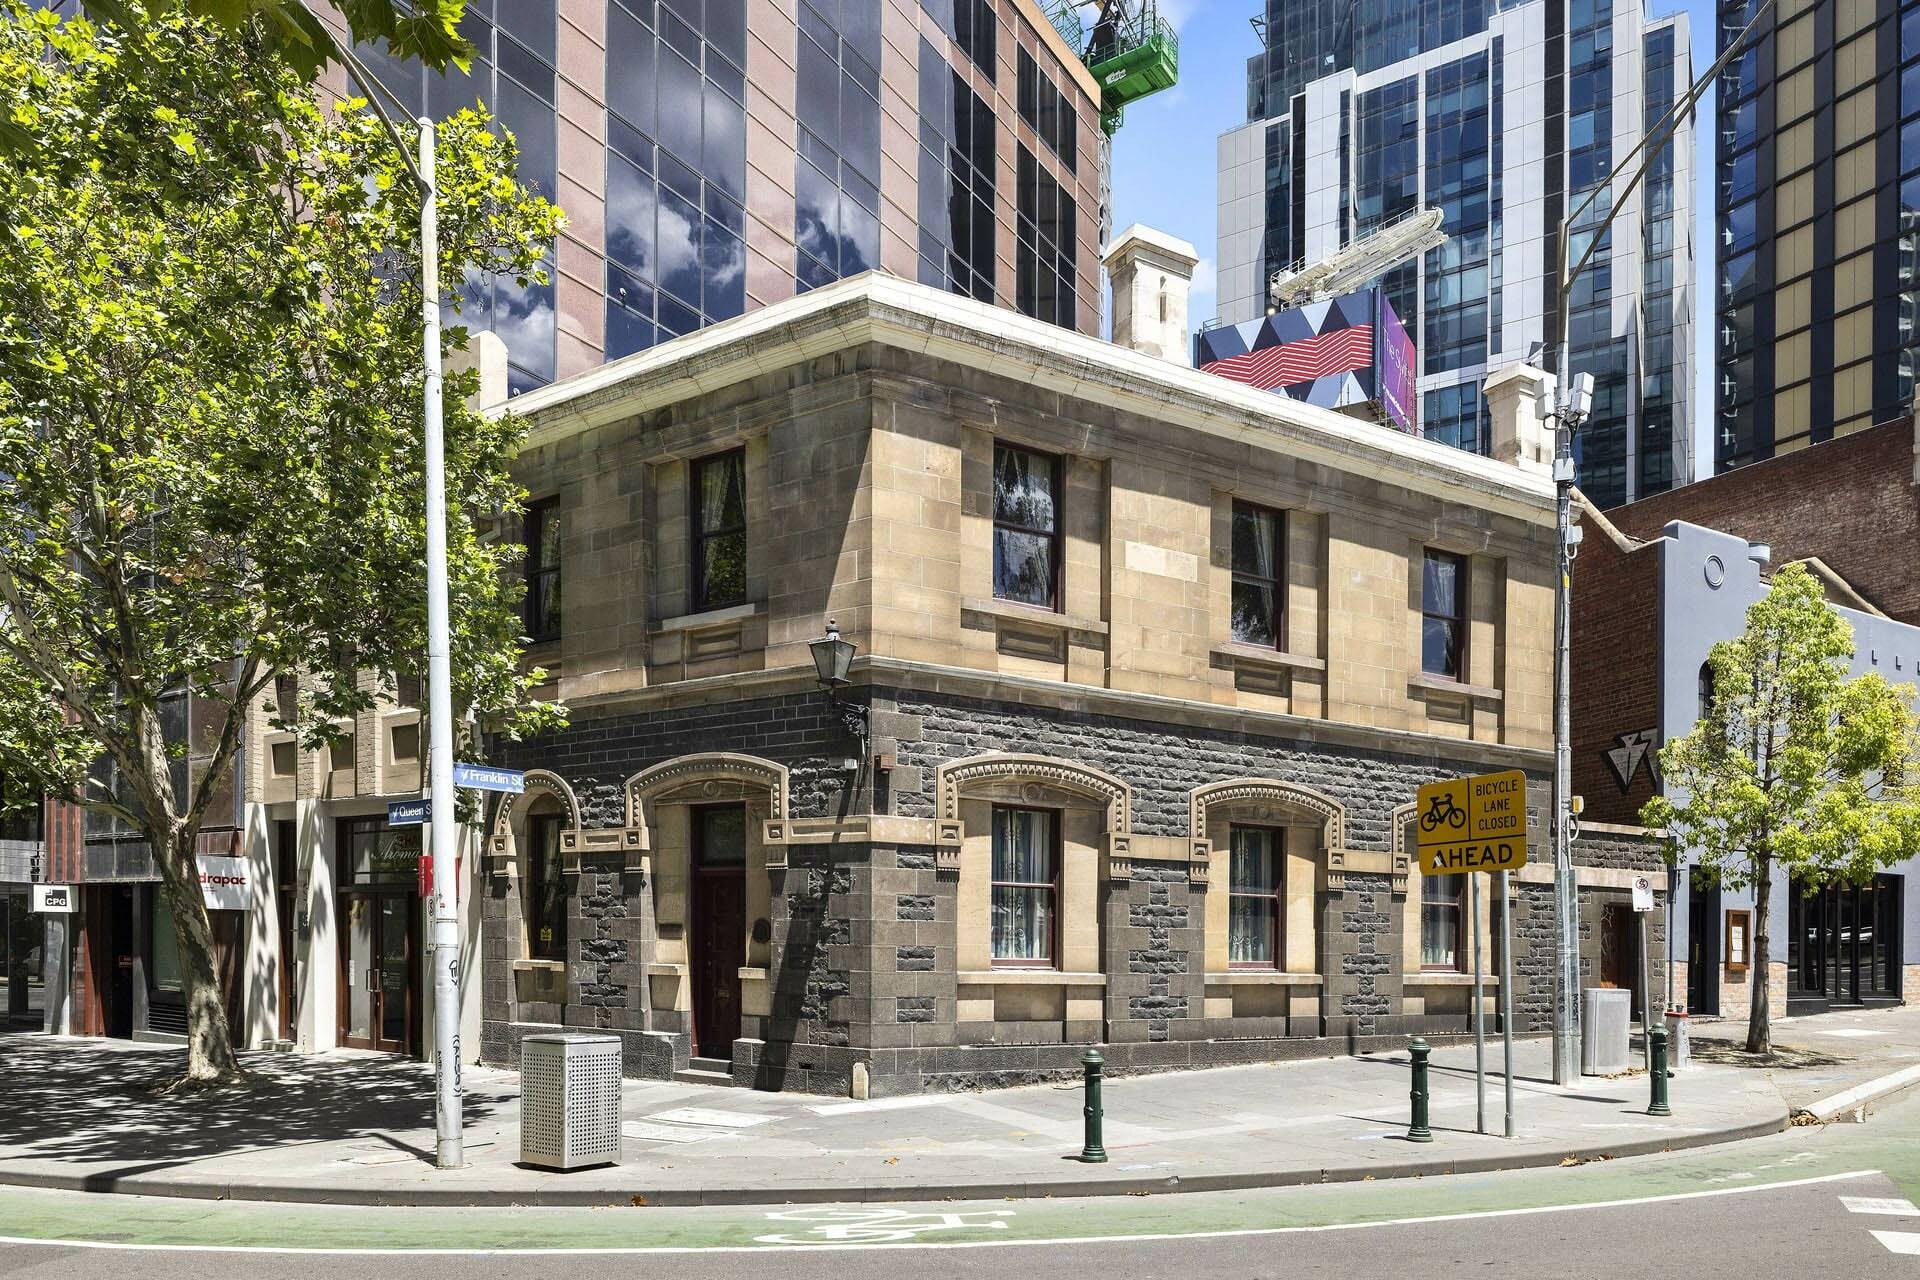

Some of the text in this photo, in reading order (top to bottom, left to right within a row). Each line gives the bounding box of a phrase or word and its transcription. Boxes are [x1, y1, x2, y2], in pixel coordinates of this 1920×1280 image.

[470, 769, 509, 785] Franklin
[1476, 779, 1518, 797] BICYCLE
[399, 803, 433, 817] Queen S
[1483, 798, 1510, 813] LANE
[1478, 815, 1517, 831] CLOSED
[1432, 844, 1513, 869] AHEAD
[198, 872, 247, 888] drapac
[46, 897, 66, 906] CPG
